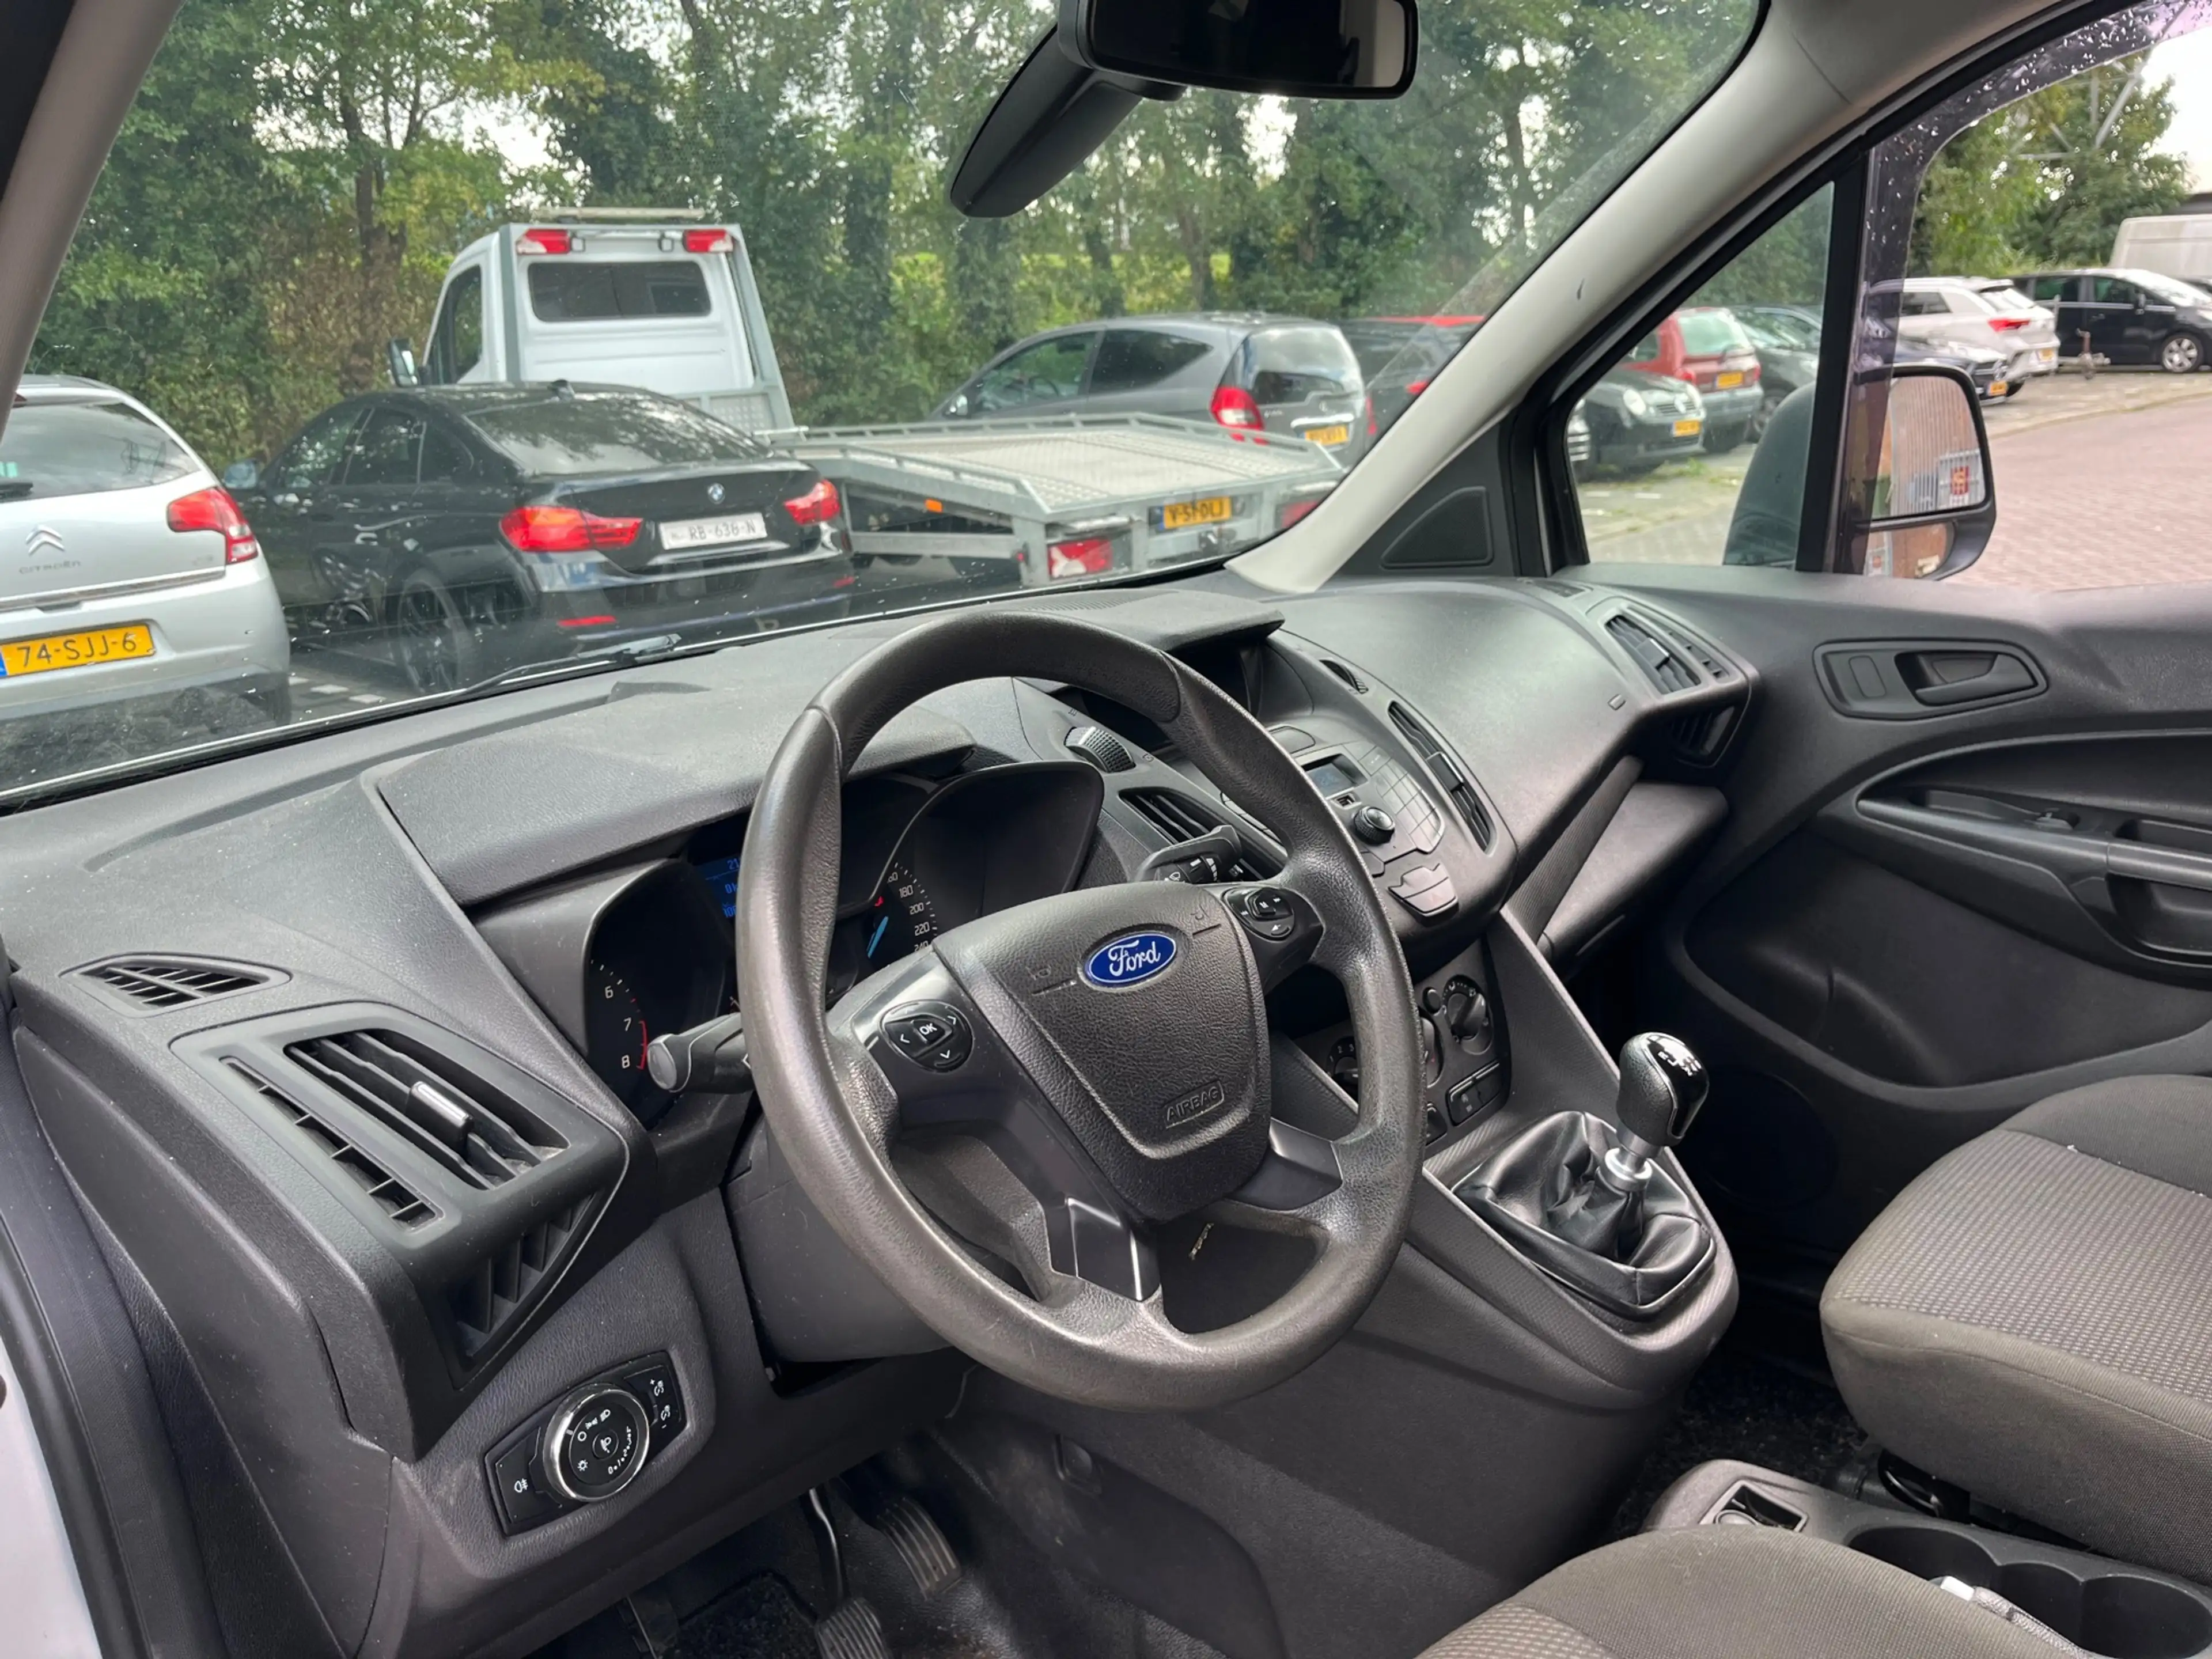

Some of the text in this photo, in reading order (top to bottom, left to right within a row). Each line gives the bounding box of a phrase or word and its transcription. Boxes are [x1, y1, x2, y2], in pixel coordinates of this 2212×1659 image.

[17, 632, 137, 667] 74-SJJ-6
[899, 884, 914, 898] 180
[909, 902, 925, 915] 200
[914, 921, 930, 936] 220
[1108, 940, 1161, 977] Ford
[605, 986, 613, 999] 6
[623, 1017, 632, 1032] 7
[919, 1022, 938, 1036] OK
[622, 1055, 630, 1069] 8
[1166, 1085, 1219, 1122] AIRBAG
